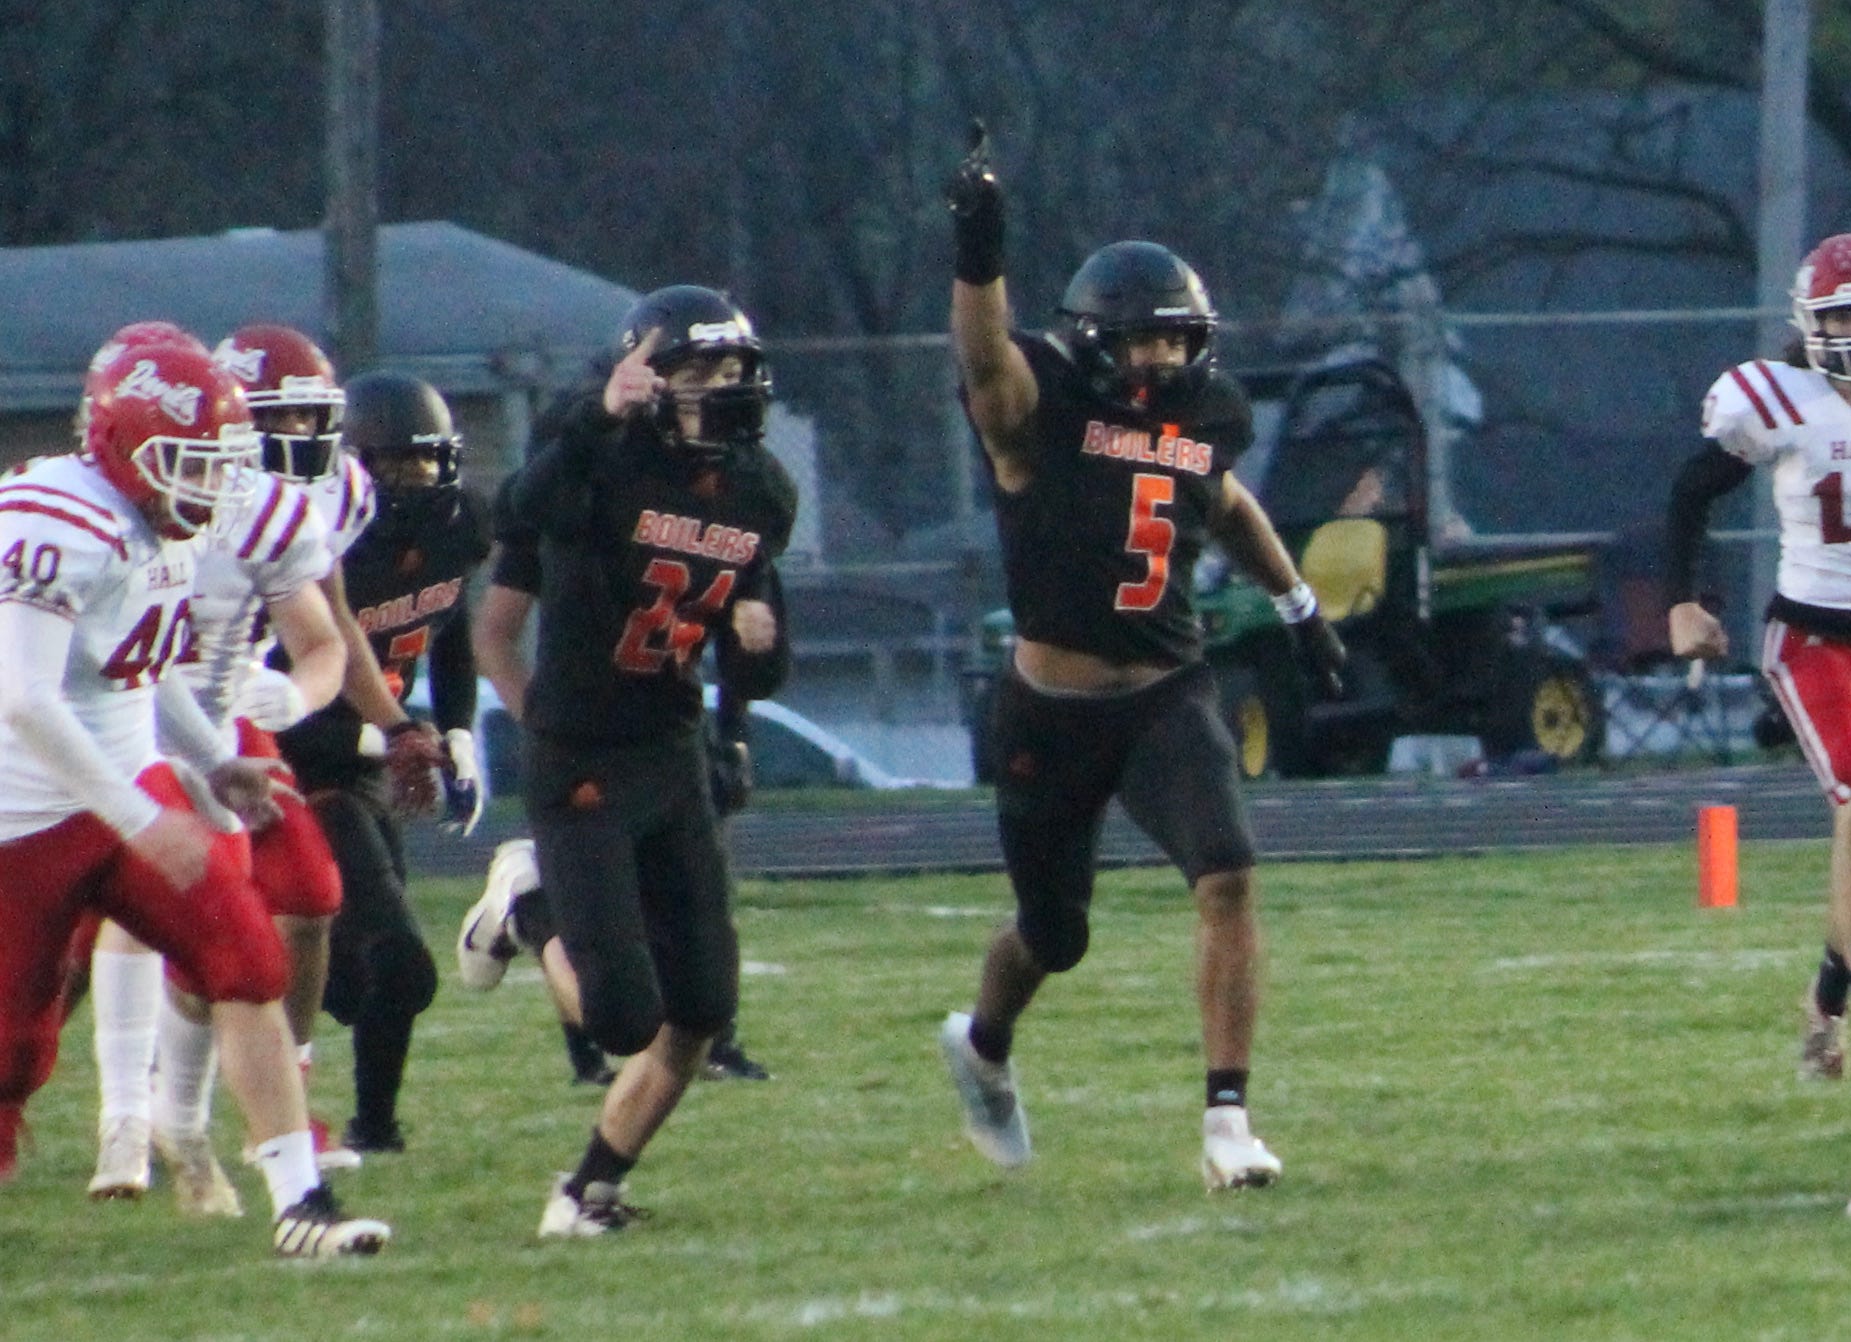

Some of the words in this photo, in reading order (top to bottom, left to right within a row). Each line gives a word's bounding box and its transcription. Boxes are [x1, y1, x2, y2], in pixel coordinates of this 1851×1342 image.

[1081, 420, 1213, 475] BOILERS
[2, 539, 61, 586] 40
[632, 509, 761, 566] BOILERS
[1114, 472, 1176, 611] 5
